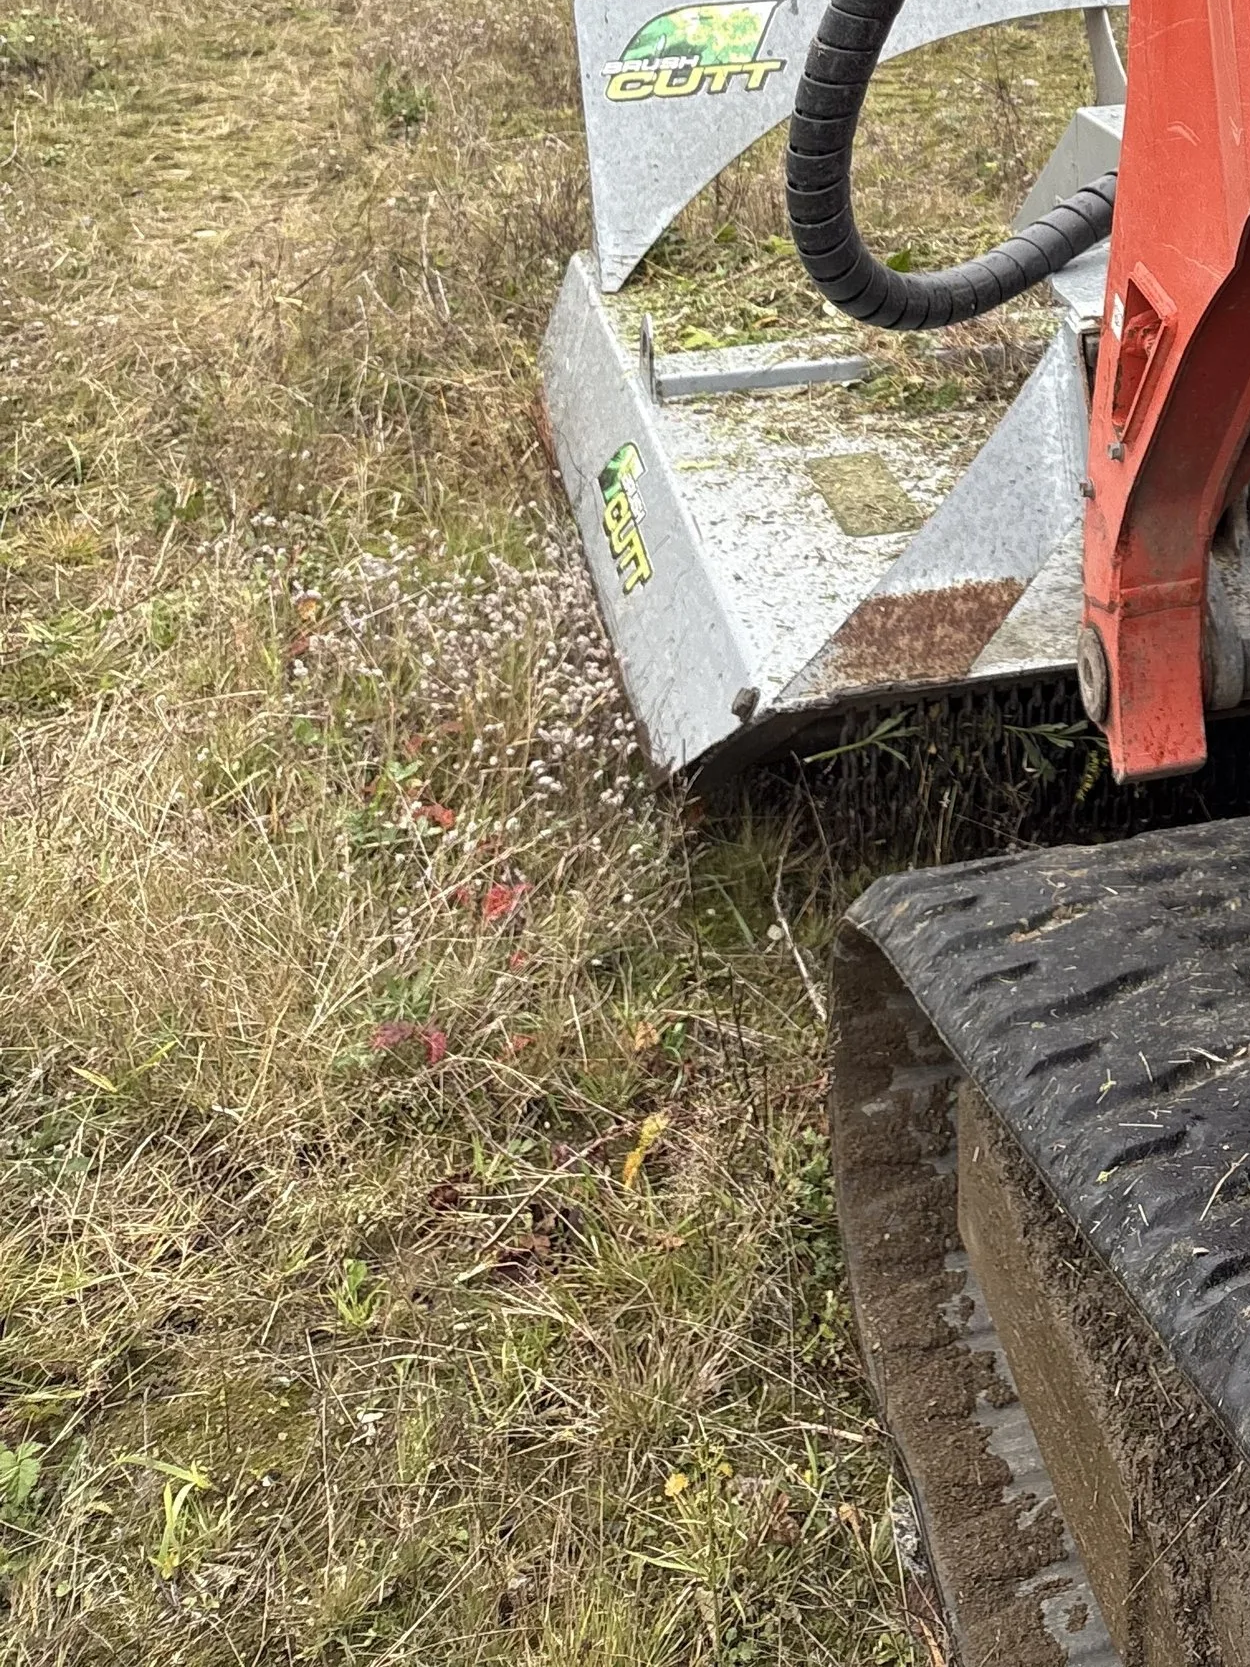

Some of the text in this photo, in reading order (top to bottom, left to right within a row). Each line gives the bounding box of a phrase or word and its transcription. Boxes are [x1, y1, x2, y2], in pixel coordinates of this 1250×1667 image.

[602, 54, 700, 76] BRUSH
[606, 60, 786, 102] CUTT
[602, 491, 654, 596] CUTT
